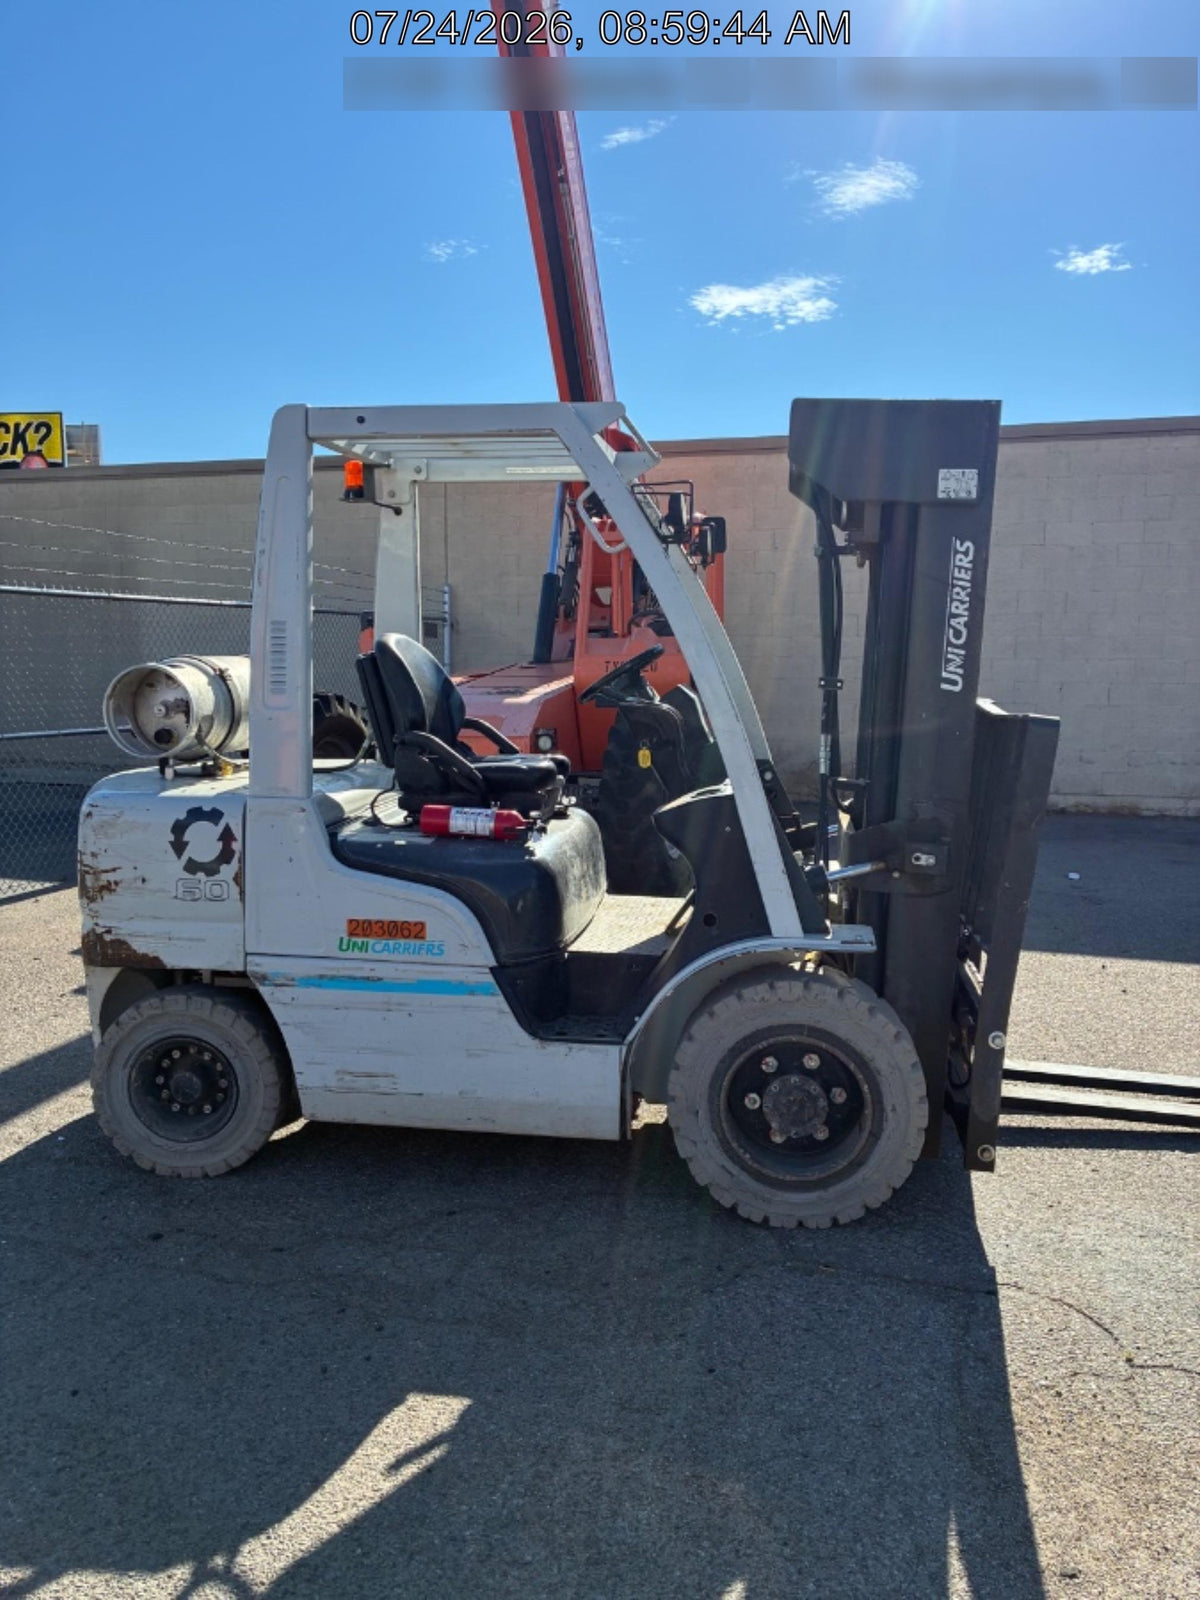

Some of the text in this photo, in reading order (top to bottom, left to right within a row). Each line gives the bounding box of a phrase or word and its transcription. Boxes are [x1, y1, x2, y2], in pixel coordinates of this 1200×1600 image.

[940, 539, 976, 693] UNICARRIERS
[175, 878, 230, 902] 60
[348, 919, 426, 939] 203062
